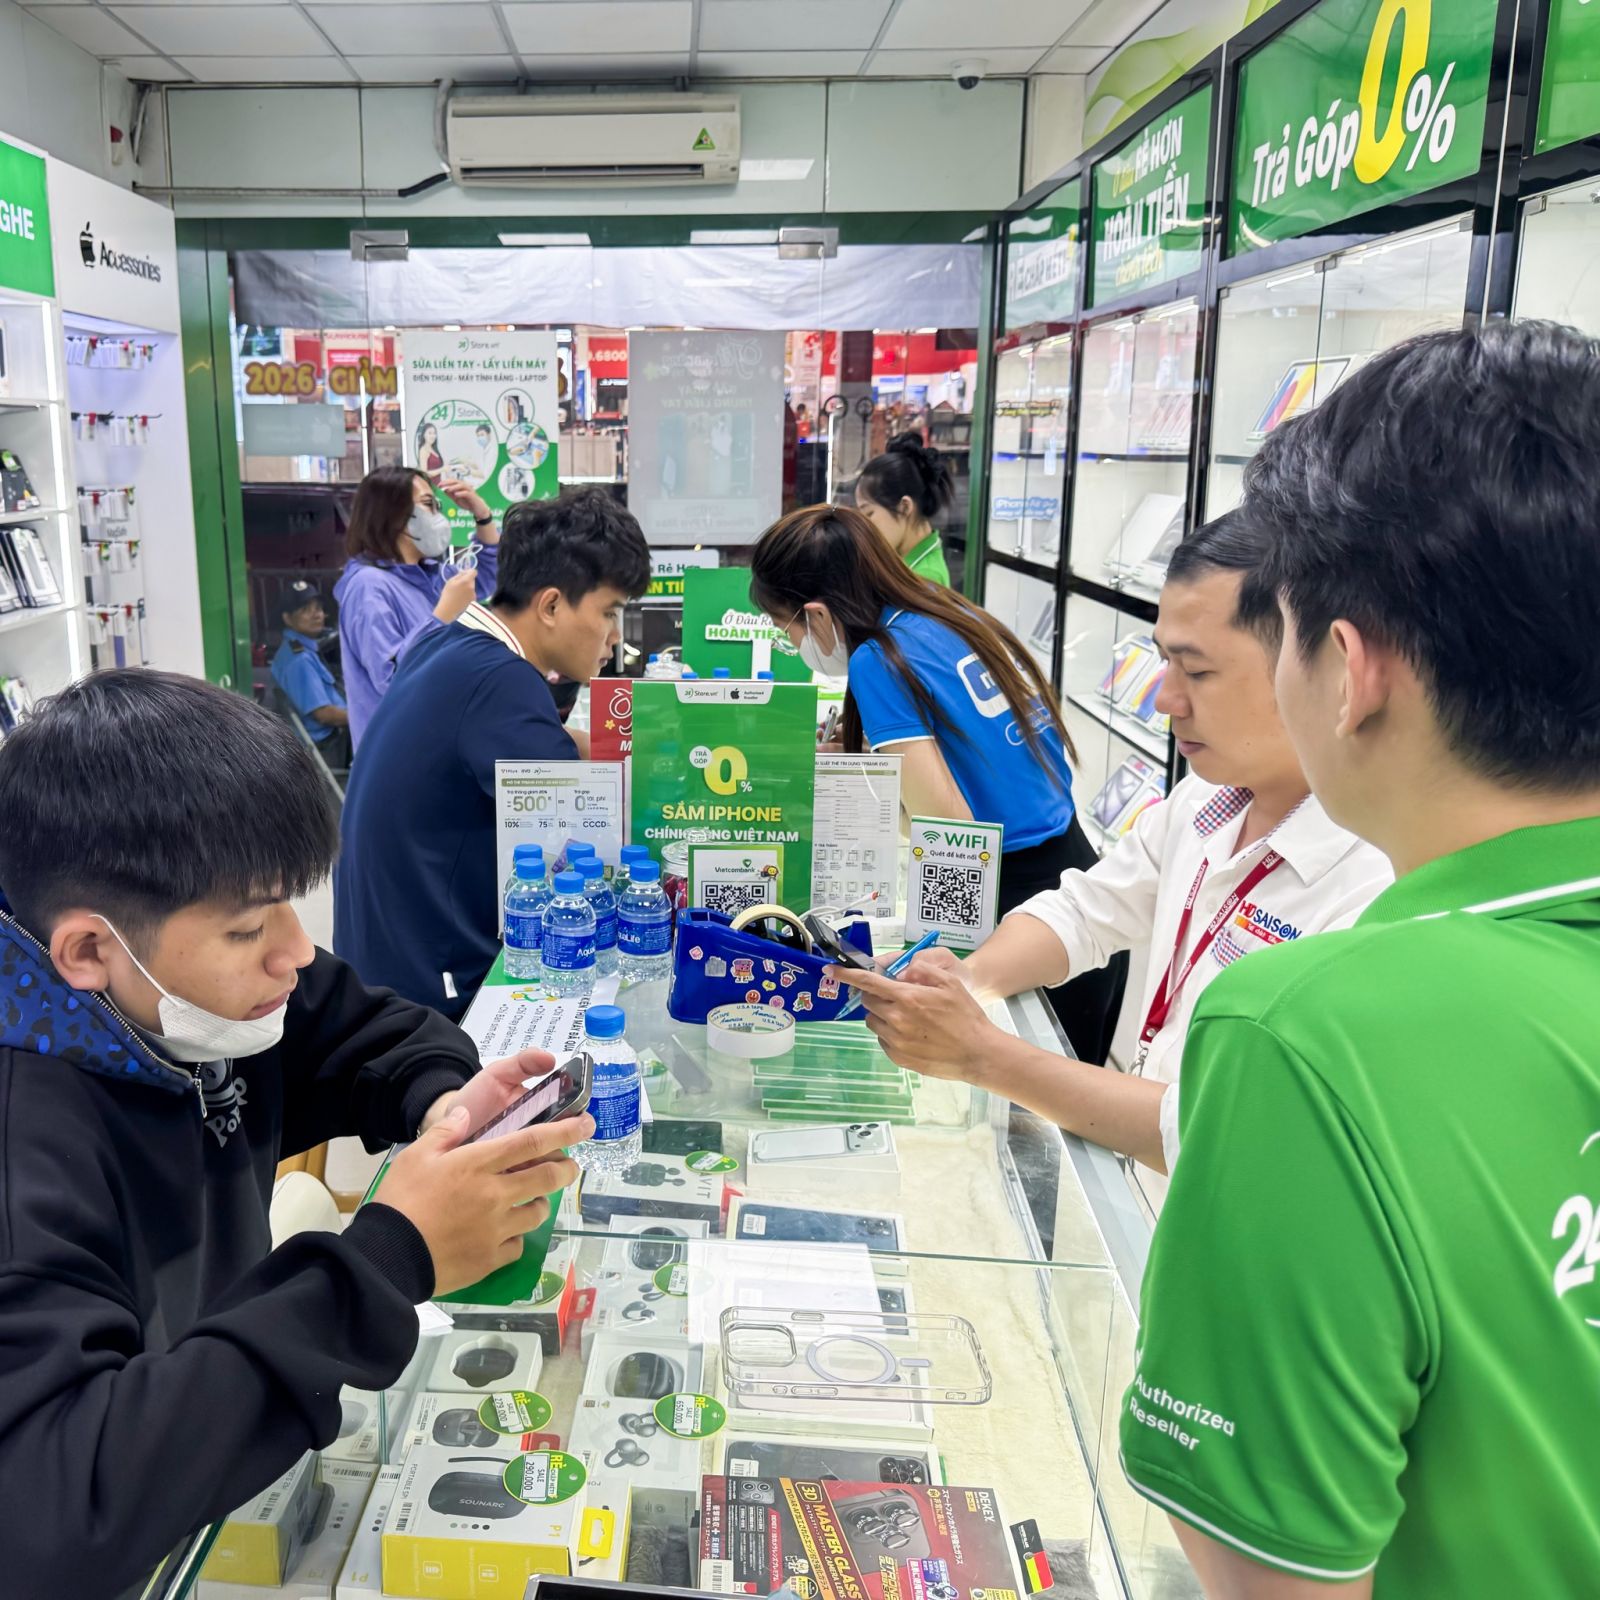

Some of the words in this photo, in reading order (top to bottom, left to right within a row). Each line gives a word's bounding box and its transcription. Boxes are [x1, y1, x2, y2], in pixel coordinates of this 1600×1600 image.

[1150, 115, 1183, 173] HƠN
[1251, 123, 1291, 207] Trả
[1294, 98, 1360, 191] Góp
[1103, 194, 1144, 262] HOÀN
[1146, 162, 1190, 241] TIỀN
[100, 240, 161, 283] Accessories
[413, 357, 431, 369] SỬA
[457, 360, 475, 369] TAY
[526, 357, 547, 369] MÁY
[244, 361, 316, 396] 2026
[329, 356, 398, 397] GIẢM
[519, 374, 548, 382] LAPTOP
[431, 404, 449, 420] 24
[708, 626, 750, 639] HOÀN
[513, 795, 547, 812] 500
[708, 805, 782, 822] IPHONE
[504, 820, 519, 828] 10%
[734, 827, 764, 843] VIỆT
[766, 830, 800, 842] NAM
[944, 832, 987, 849] WIFI
[929, 850, 945, 859] Quét
[752, 1010, 776, 1019] America
[513, 1391, 531, 1406] RẺ
[695, 1396, 709, 1409] RẺ
[1135, 1373, 1235, 1437] Authorized
[506, 1402, 515, 1415] SALE
[674, 1400, 683, 1424] 650.000
[1130, 1396, 1200, 1451] Reseller
[550, 1454, 568, 1469] RẺ
[404, 1463, 418, 1490] PORTABLE
[523, 1461, 535, 1491] 290.000
[536, 1468, 545, 1483] SALE
[801, 1485, 818, 1500] 3D
[458, 1498, 505, 1509] SOUNARC
[978, 1491, 995, 1522] DEKEY
[812, 1504, 844, 1555] MASTER
[834, 1556, 864, 1600] GLASS
[824, 1555, 840, 1583] CAMERA
[834, 1582, 847, 1599] LENS
